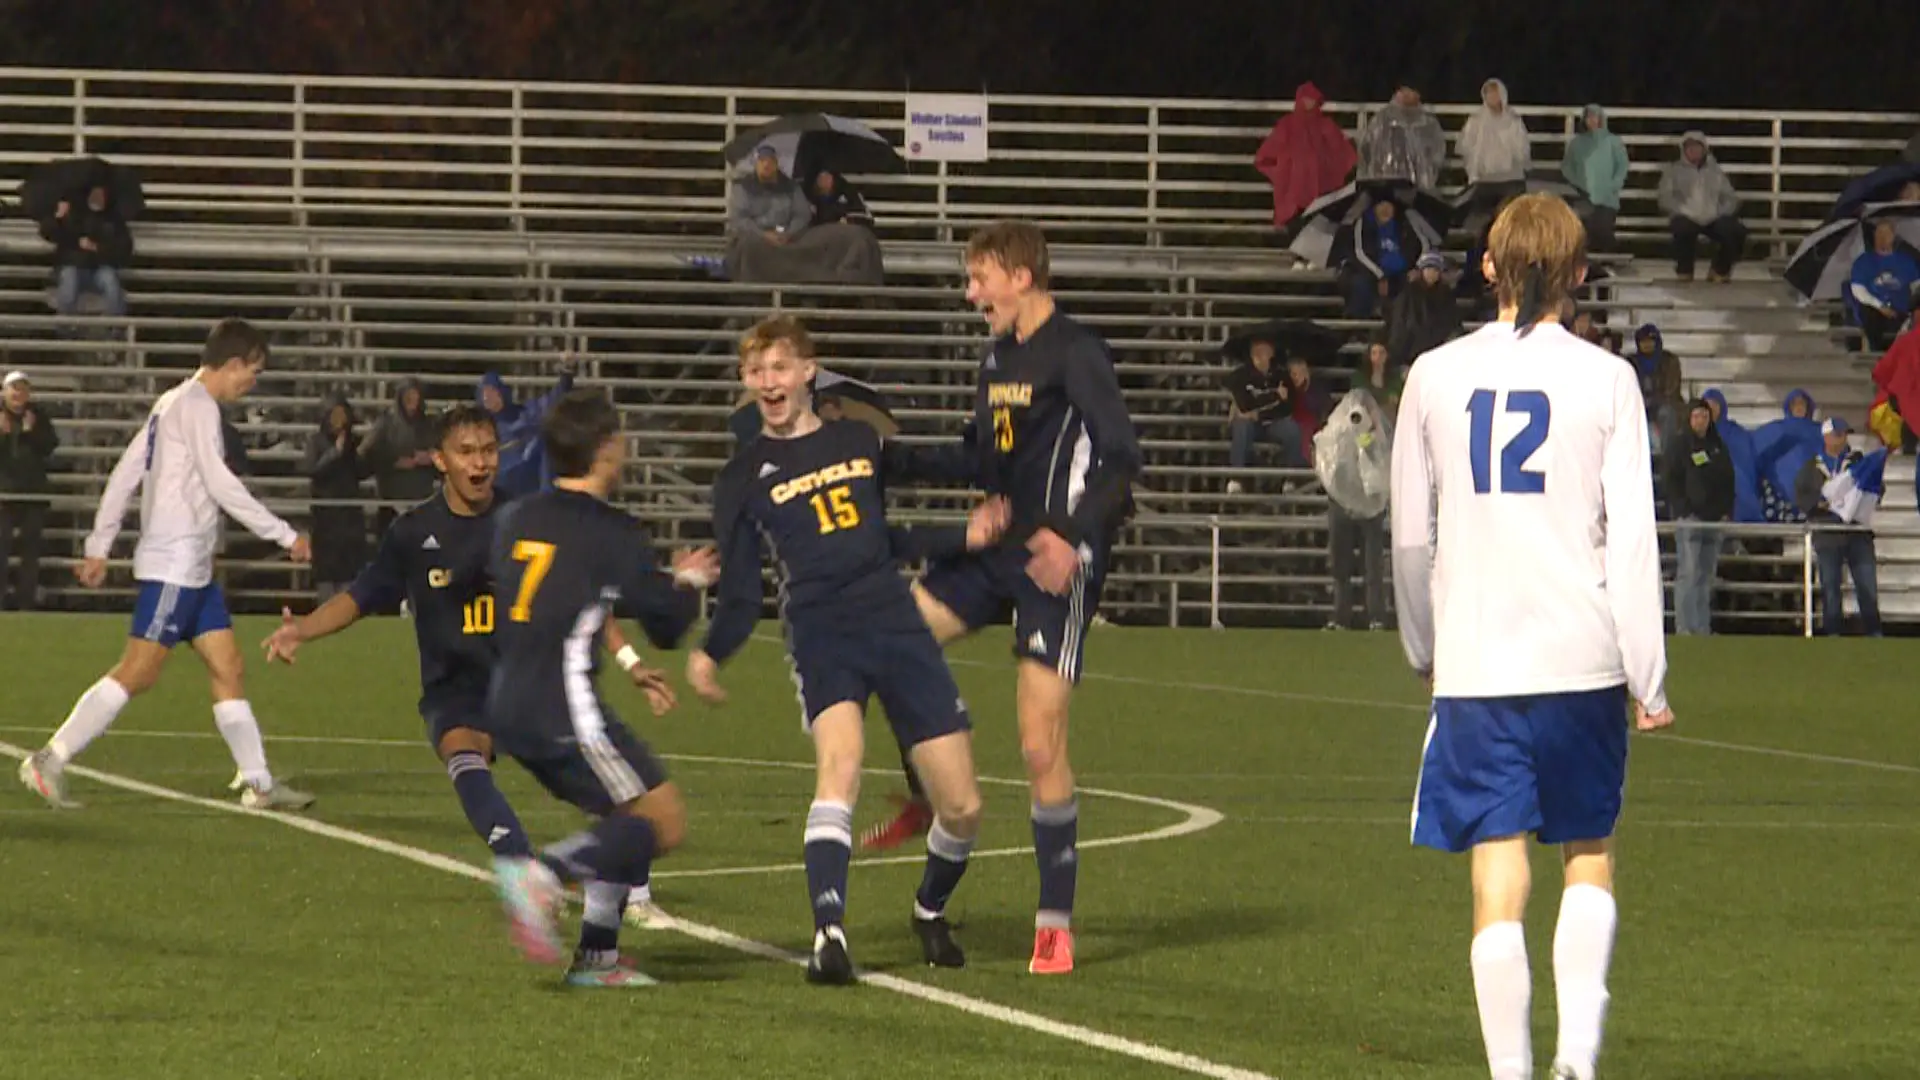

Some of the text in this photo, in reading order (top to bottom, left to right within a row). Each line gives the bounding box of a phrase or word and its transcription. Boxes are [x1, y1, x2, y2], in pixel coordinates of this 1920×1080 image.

[1465, 388, 1551, 494] 12
[769, 457, 874, 505] CATHOLIC
[809, 485, 861, 534] 15
[510, 540, 557, 622] 7
[462, 595, 494, 634] 10
